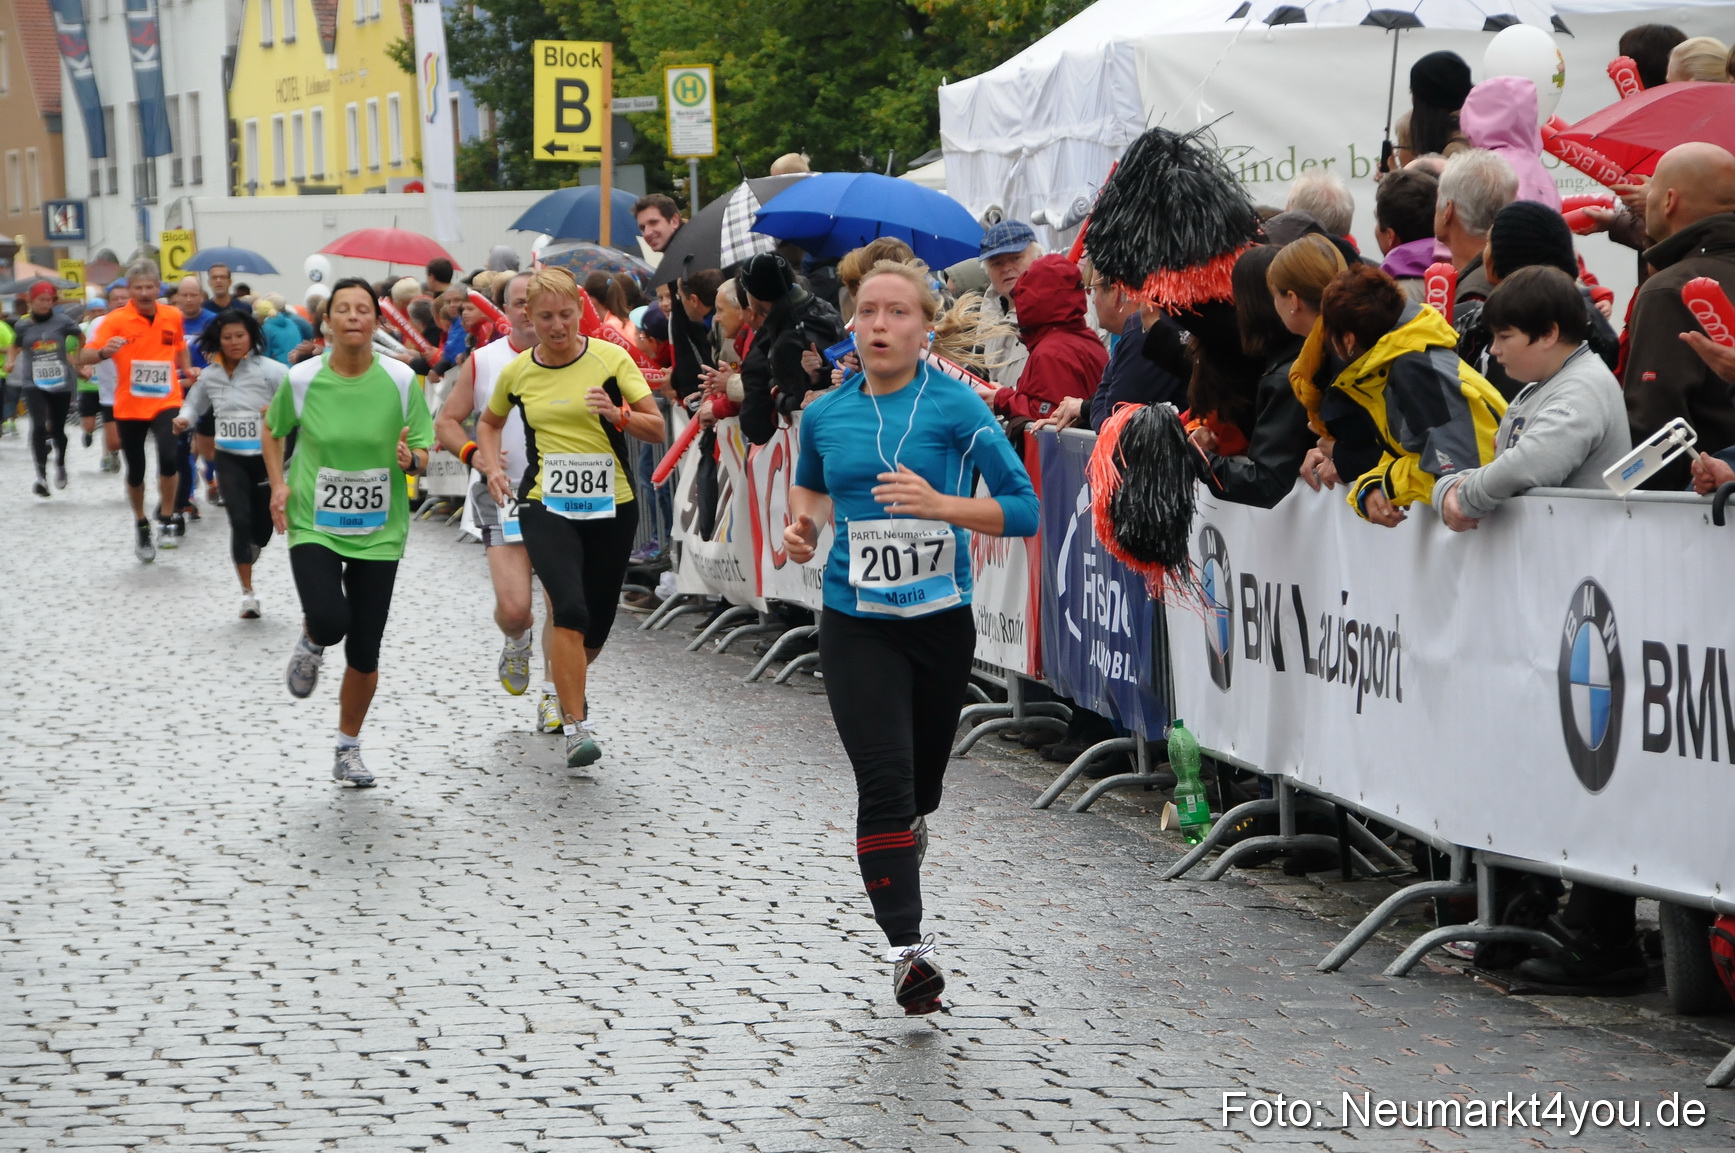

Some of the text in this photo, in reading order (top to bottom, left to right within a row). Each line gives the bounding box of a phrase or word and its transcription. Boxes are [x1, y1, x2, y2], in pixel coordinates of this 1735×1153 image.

[544, 46, 603, 68] Block
[275, 76, 300, 104] HOTEL
[555, 77, 591, 133] B
[1555, 139, 1596, 172] BKK
[1599, 164, 1634, 187] udi
[162, 232, 190, 242] Block
[169, 245, 186, 270] C
[134, 368, 167, 384] 2734
[220, 421, 257, 438] 3068
[550, 469, 608, 494] 2984
[323, 483, 384, 510] 2835
[564, 501, 593, 512] gisela
[851, 530, 932, 541] PARTL Neumarkt
[861, 539, 944, 582] 2017
[885, 586, 926, 606] Maria
